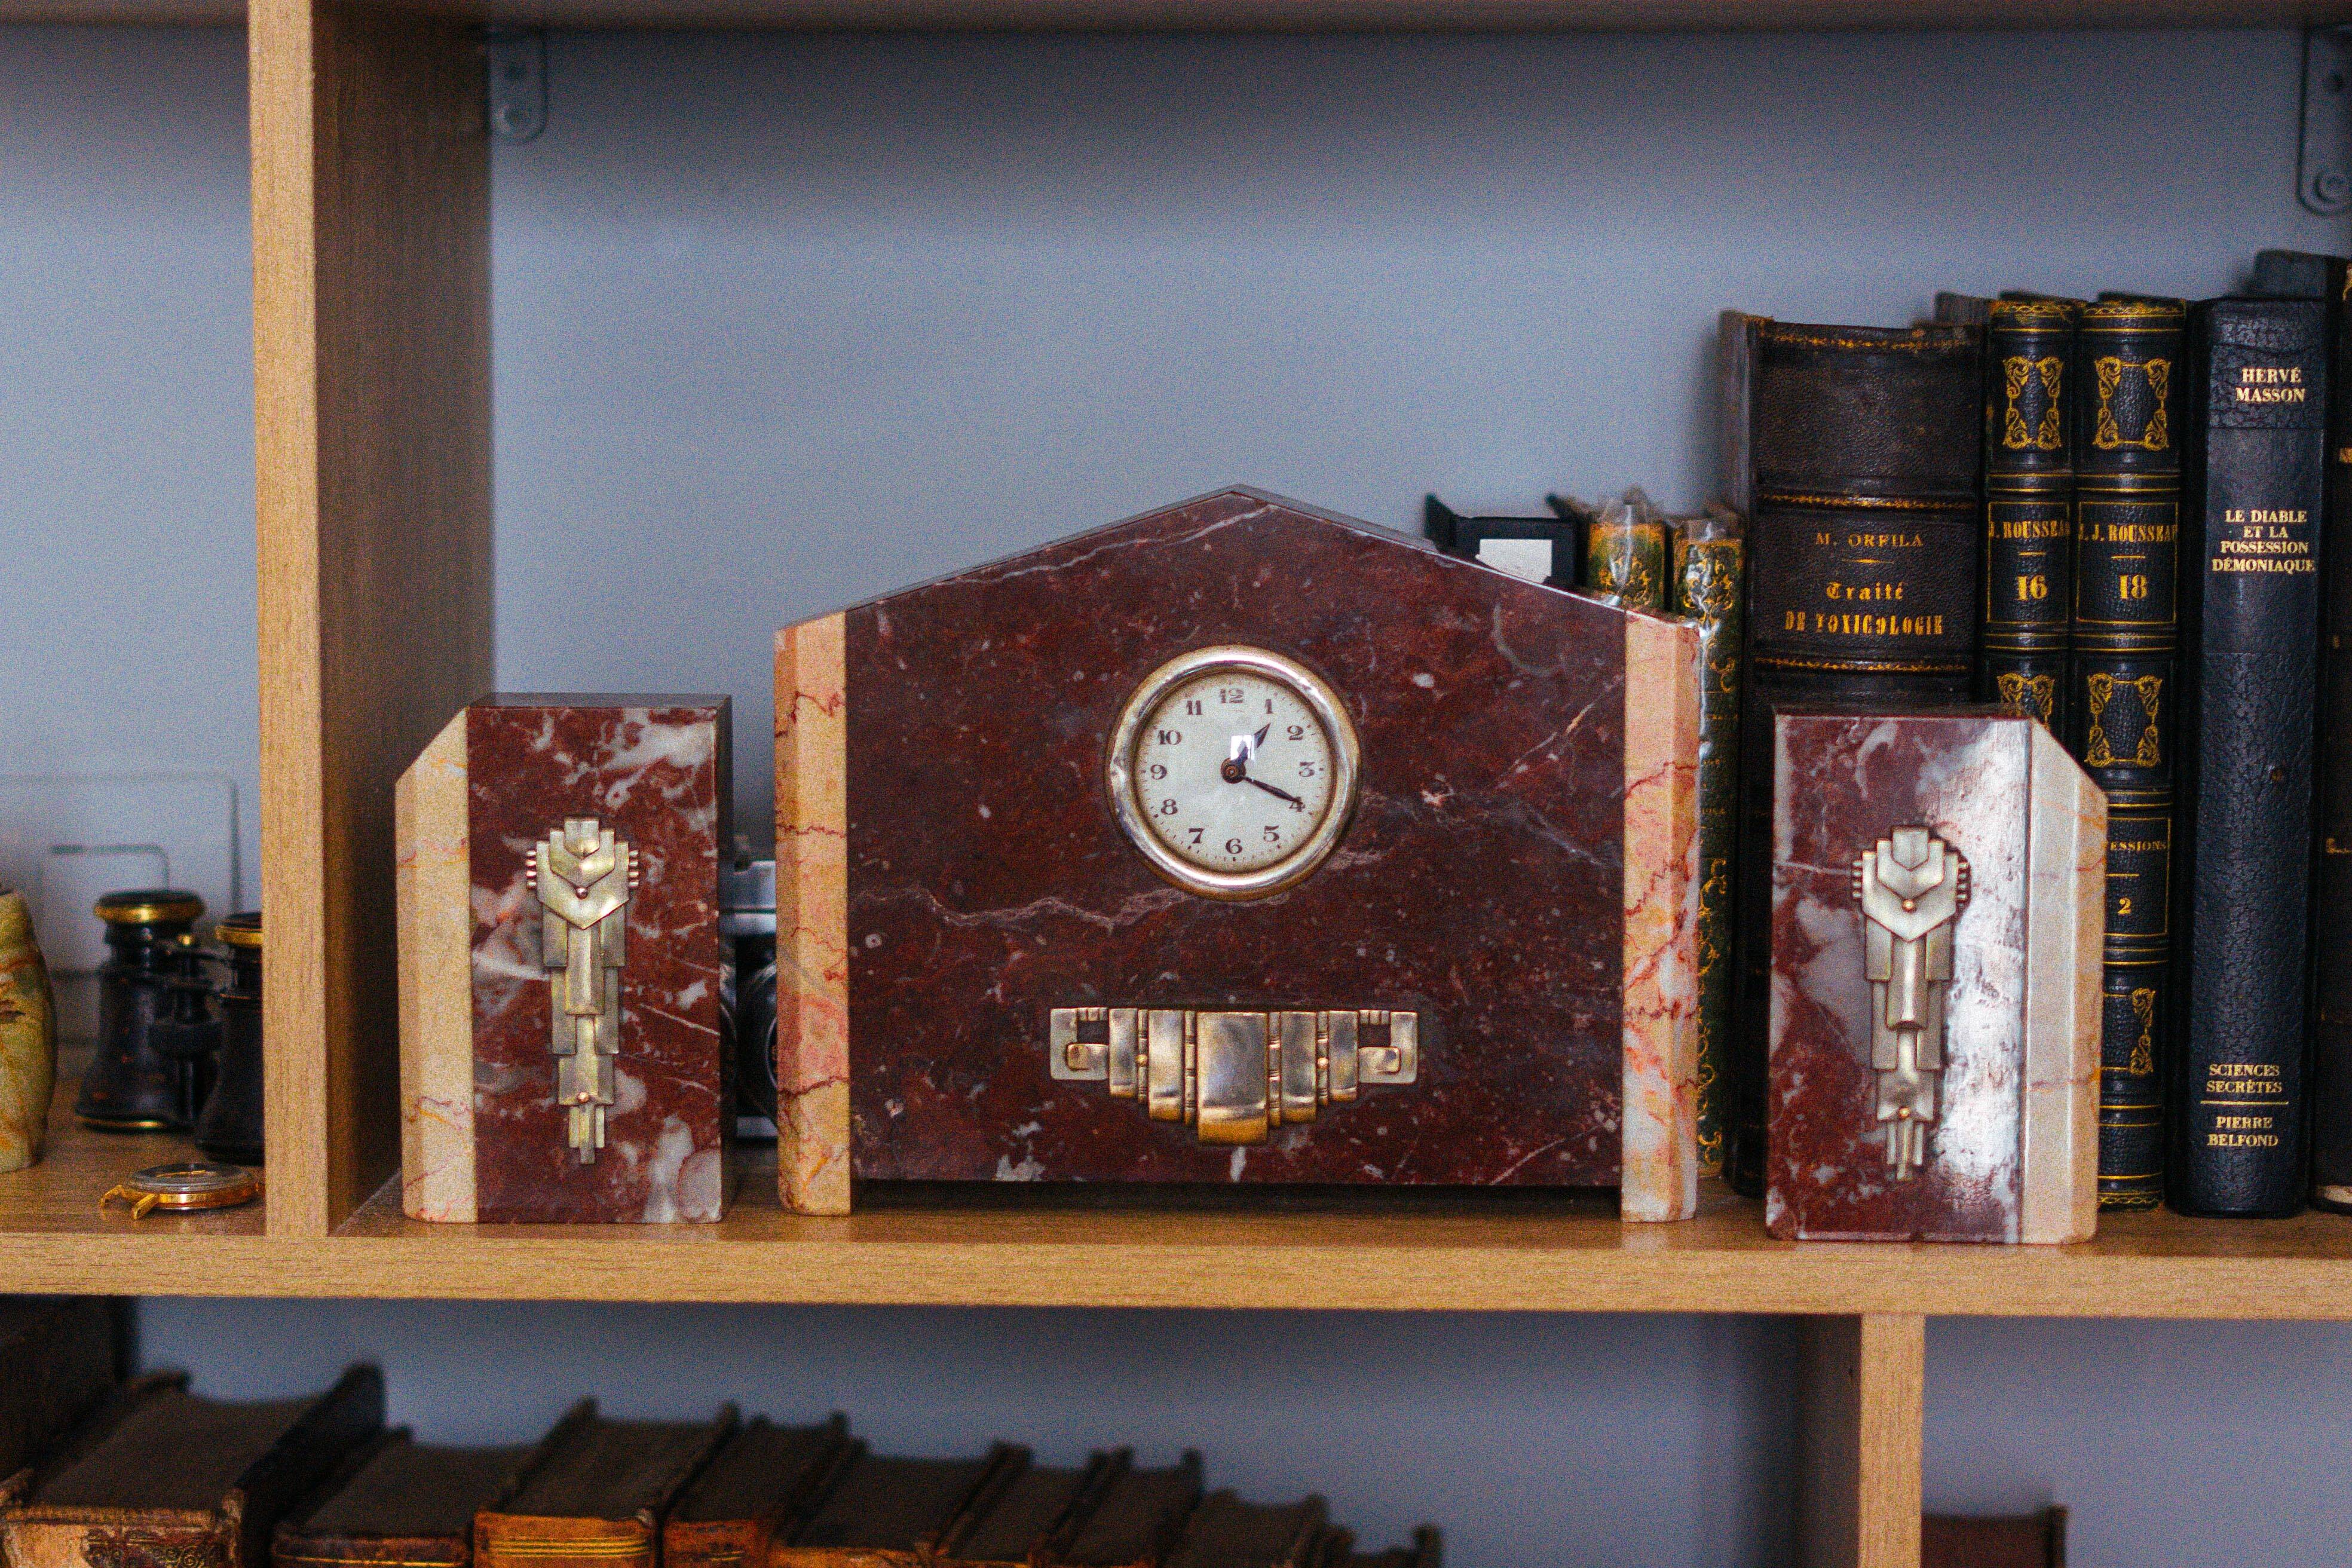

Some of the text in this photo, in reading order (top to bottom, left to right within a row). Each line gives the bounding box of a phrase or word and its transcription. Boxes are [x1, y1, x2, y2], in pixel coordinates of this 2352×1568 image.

[2242, 368, 2301, 382] HERVÉ
[2236, 388, 2305, 402] MASSON
[2225, 510, 2307, 523] LE DIABLE
[1816, 532, 1924, 547] M. ORFILA
[2244, 526, 2288, 538] ET LA
[2221, 541, 2308, 553] POSSESSION
[2212, 557, 2314, 574] DÉMONIAQUE
[2017, 575, 2048, 601] 16
[2120, 574, 2148, 599] 18
[1786, 611, 1942, 636] DE TOXICOLOGIE
[1220, 688, 1244, 704] 12
[1186, 700, 1202, 715] 11
[1264, 699, 1273, 714] 1
[1157, 730, 1182, 746] 10
[1287, 725, 1303, 741] 2
[1150, 764, 1168, 780] 9
[1298, 761, 1315, 777] 3
[1160, 799, 1178, 815] 8
[1289, 796, 1305, 813] 4
[1188, 828, 1205, 843] 7
[1262, 826, 1280, 842] 5
[1225, 838, 1242, 854] 6
[2105, 841, 2166, 851] ESSIONS
[2117, 898, 2132, 915] 2
[2209, 1063, 2280, 1076] SCIENCES
[2216, 1116, 2273, 1129] PIERRE
[2207, 1134, 2278, 1147] BELFOND
